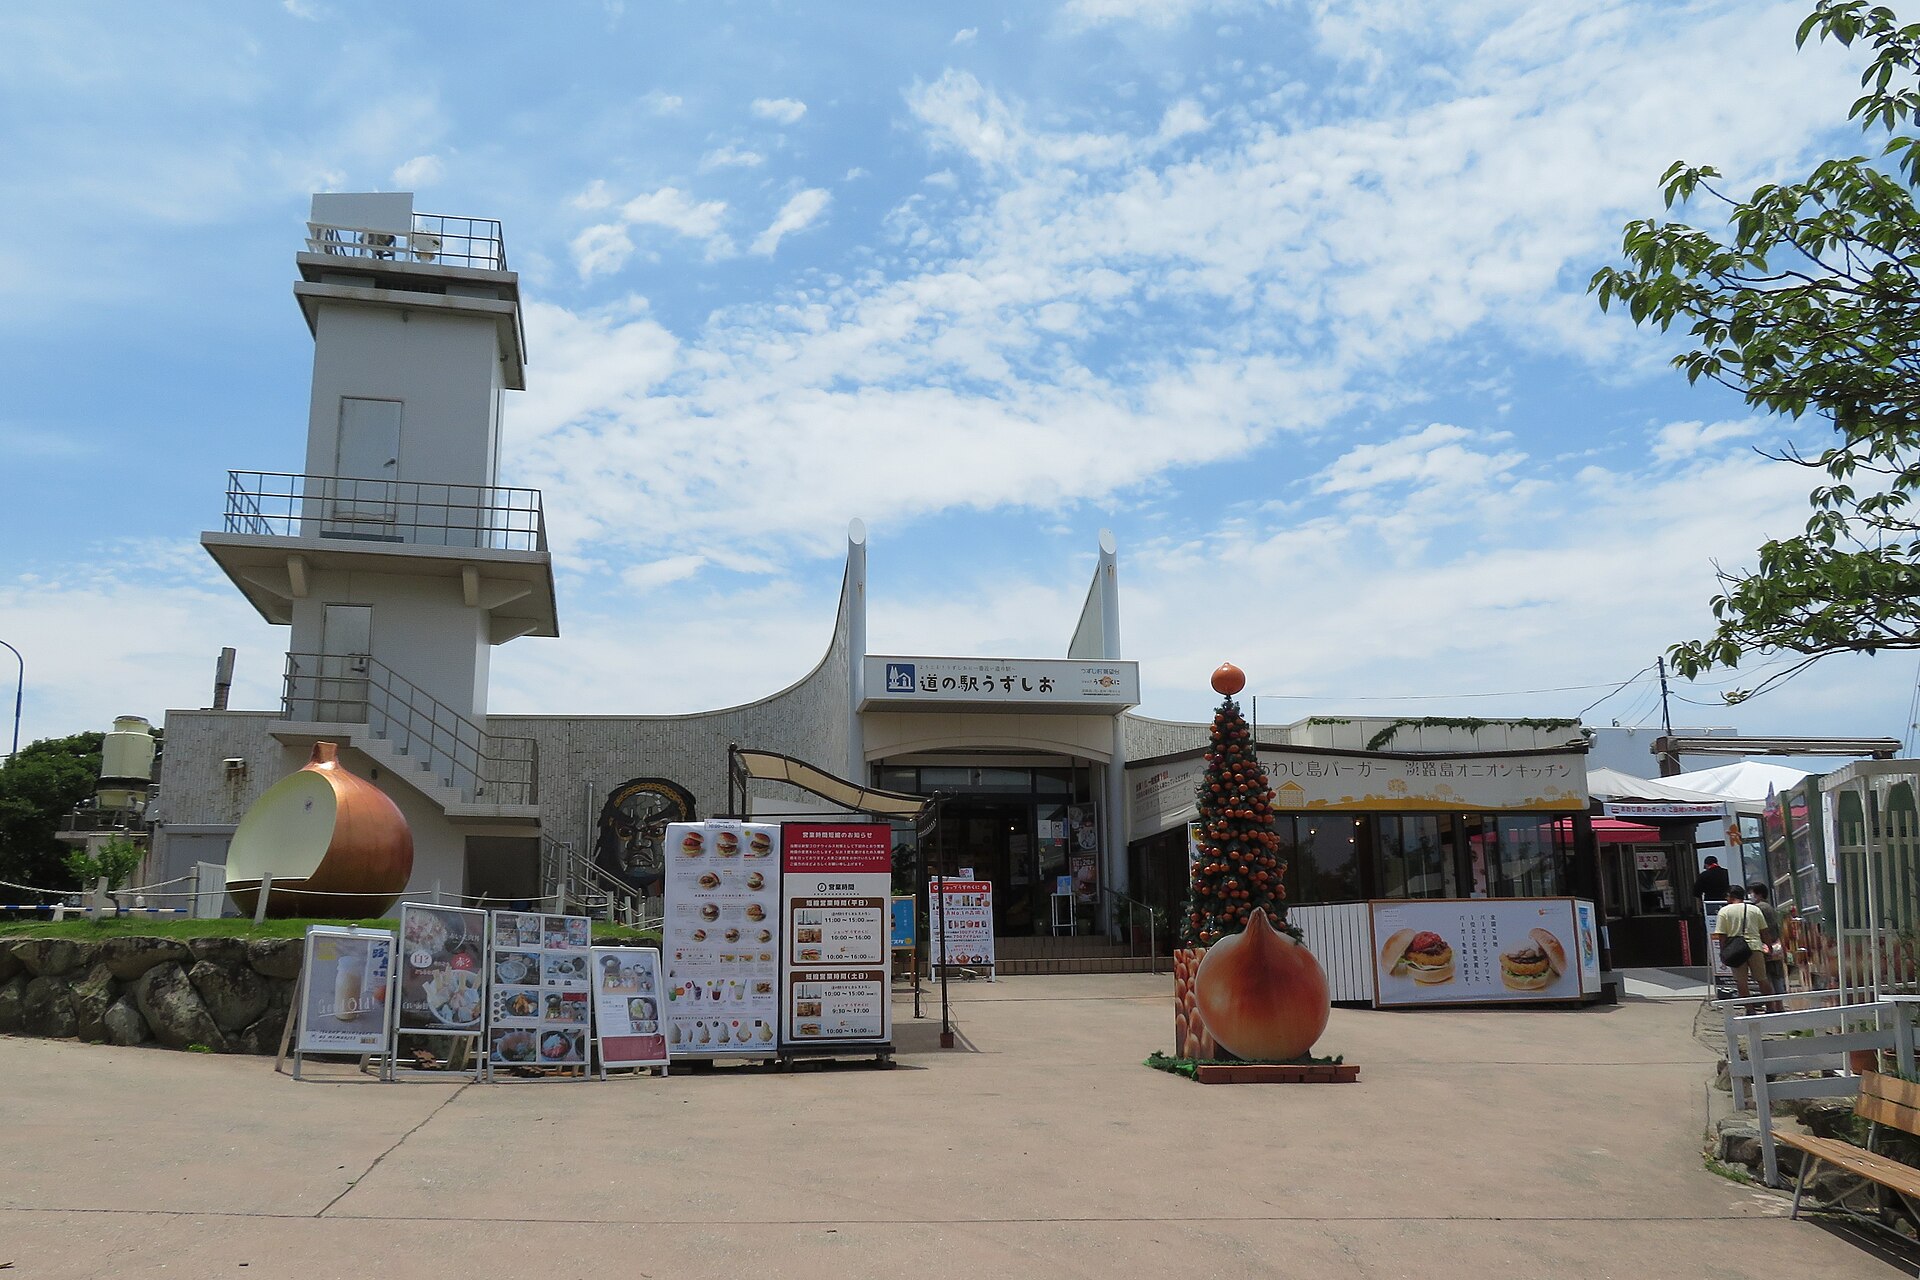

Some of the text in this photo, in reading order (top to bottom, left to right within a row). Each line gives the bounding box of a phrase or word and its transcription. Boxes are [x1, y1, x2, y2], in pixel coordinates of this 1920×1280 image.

[919, 674, 1056, 694] 道の駅うずしお
[1257, 761, 1572, 778] あわじ島バーガー 淡路島オニオンキッチン
